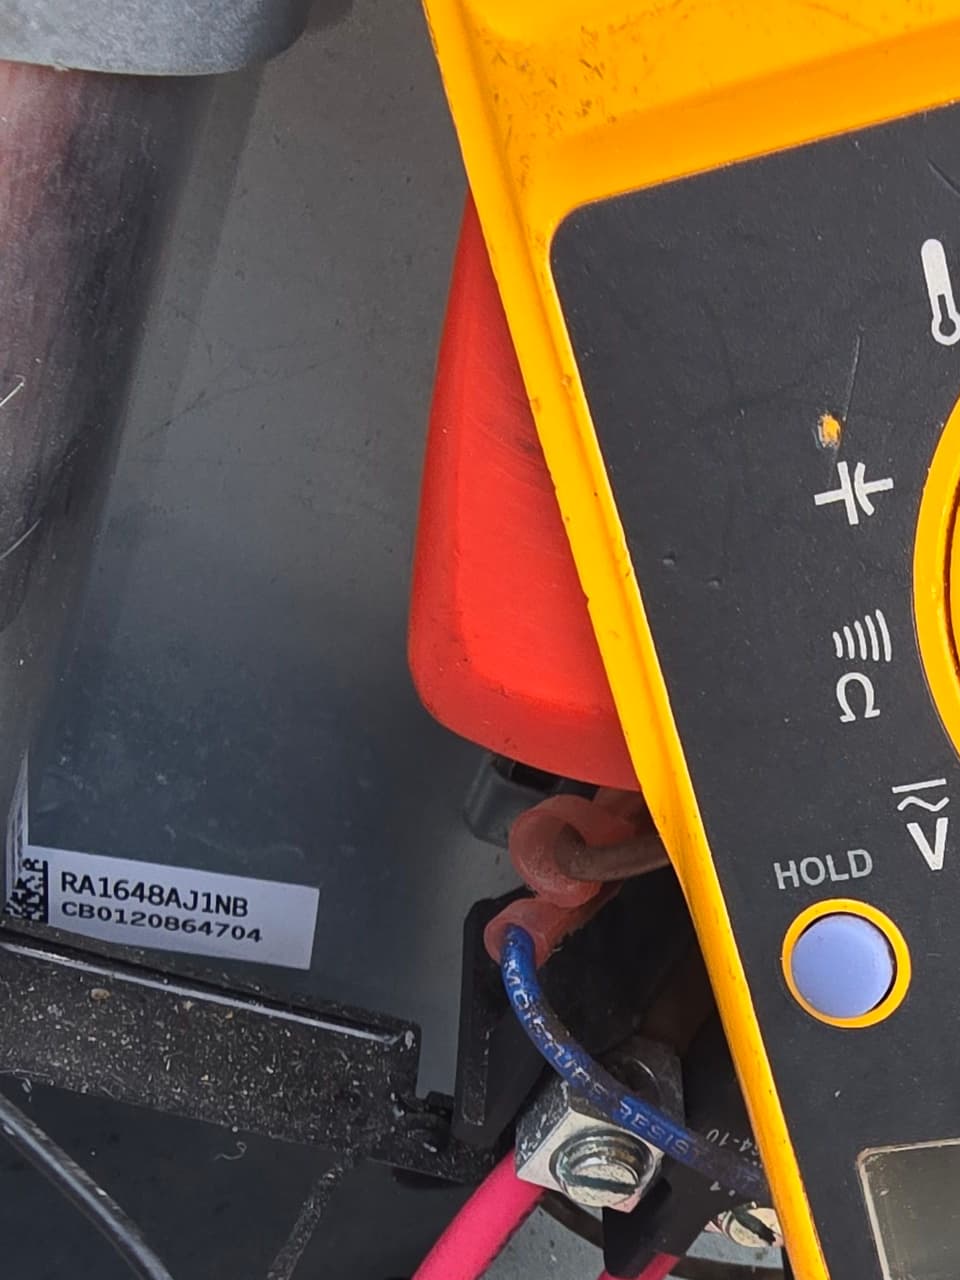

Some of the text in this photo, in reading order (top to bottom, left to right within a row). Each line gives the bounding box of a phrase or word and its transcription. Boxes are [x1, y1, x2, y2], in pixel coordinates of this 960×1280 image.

[906, 816, 949, 871] V
[773, 848, 873, 890] HOLD
[60, 871, 249, 918] RA1648AJ1NB
[61, 901, 263, 943] CB0120864704
